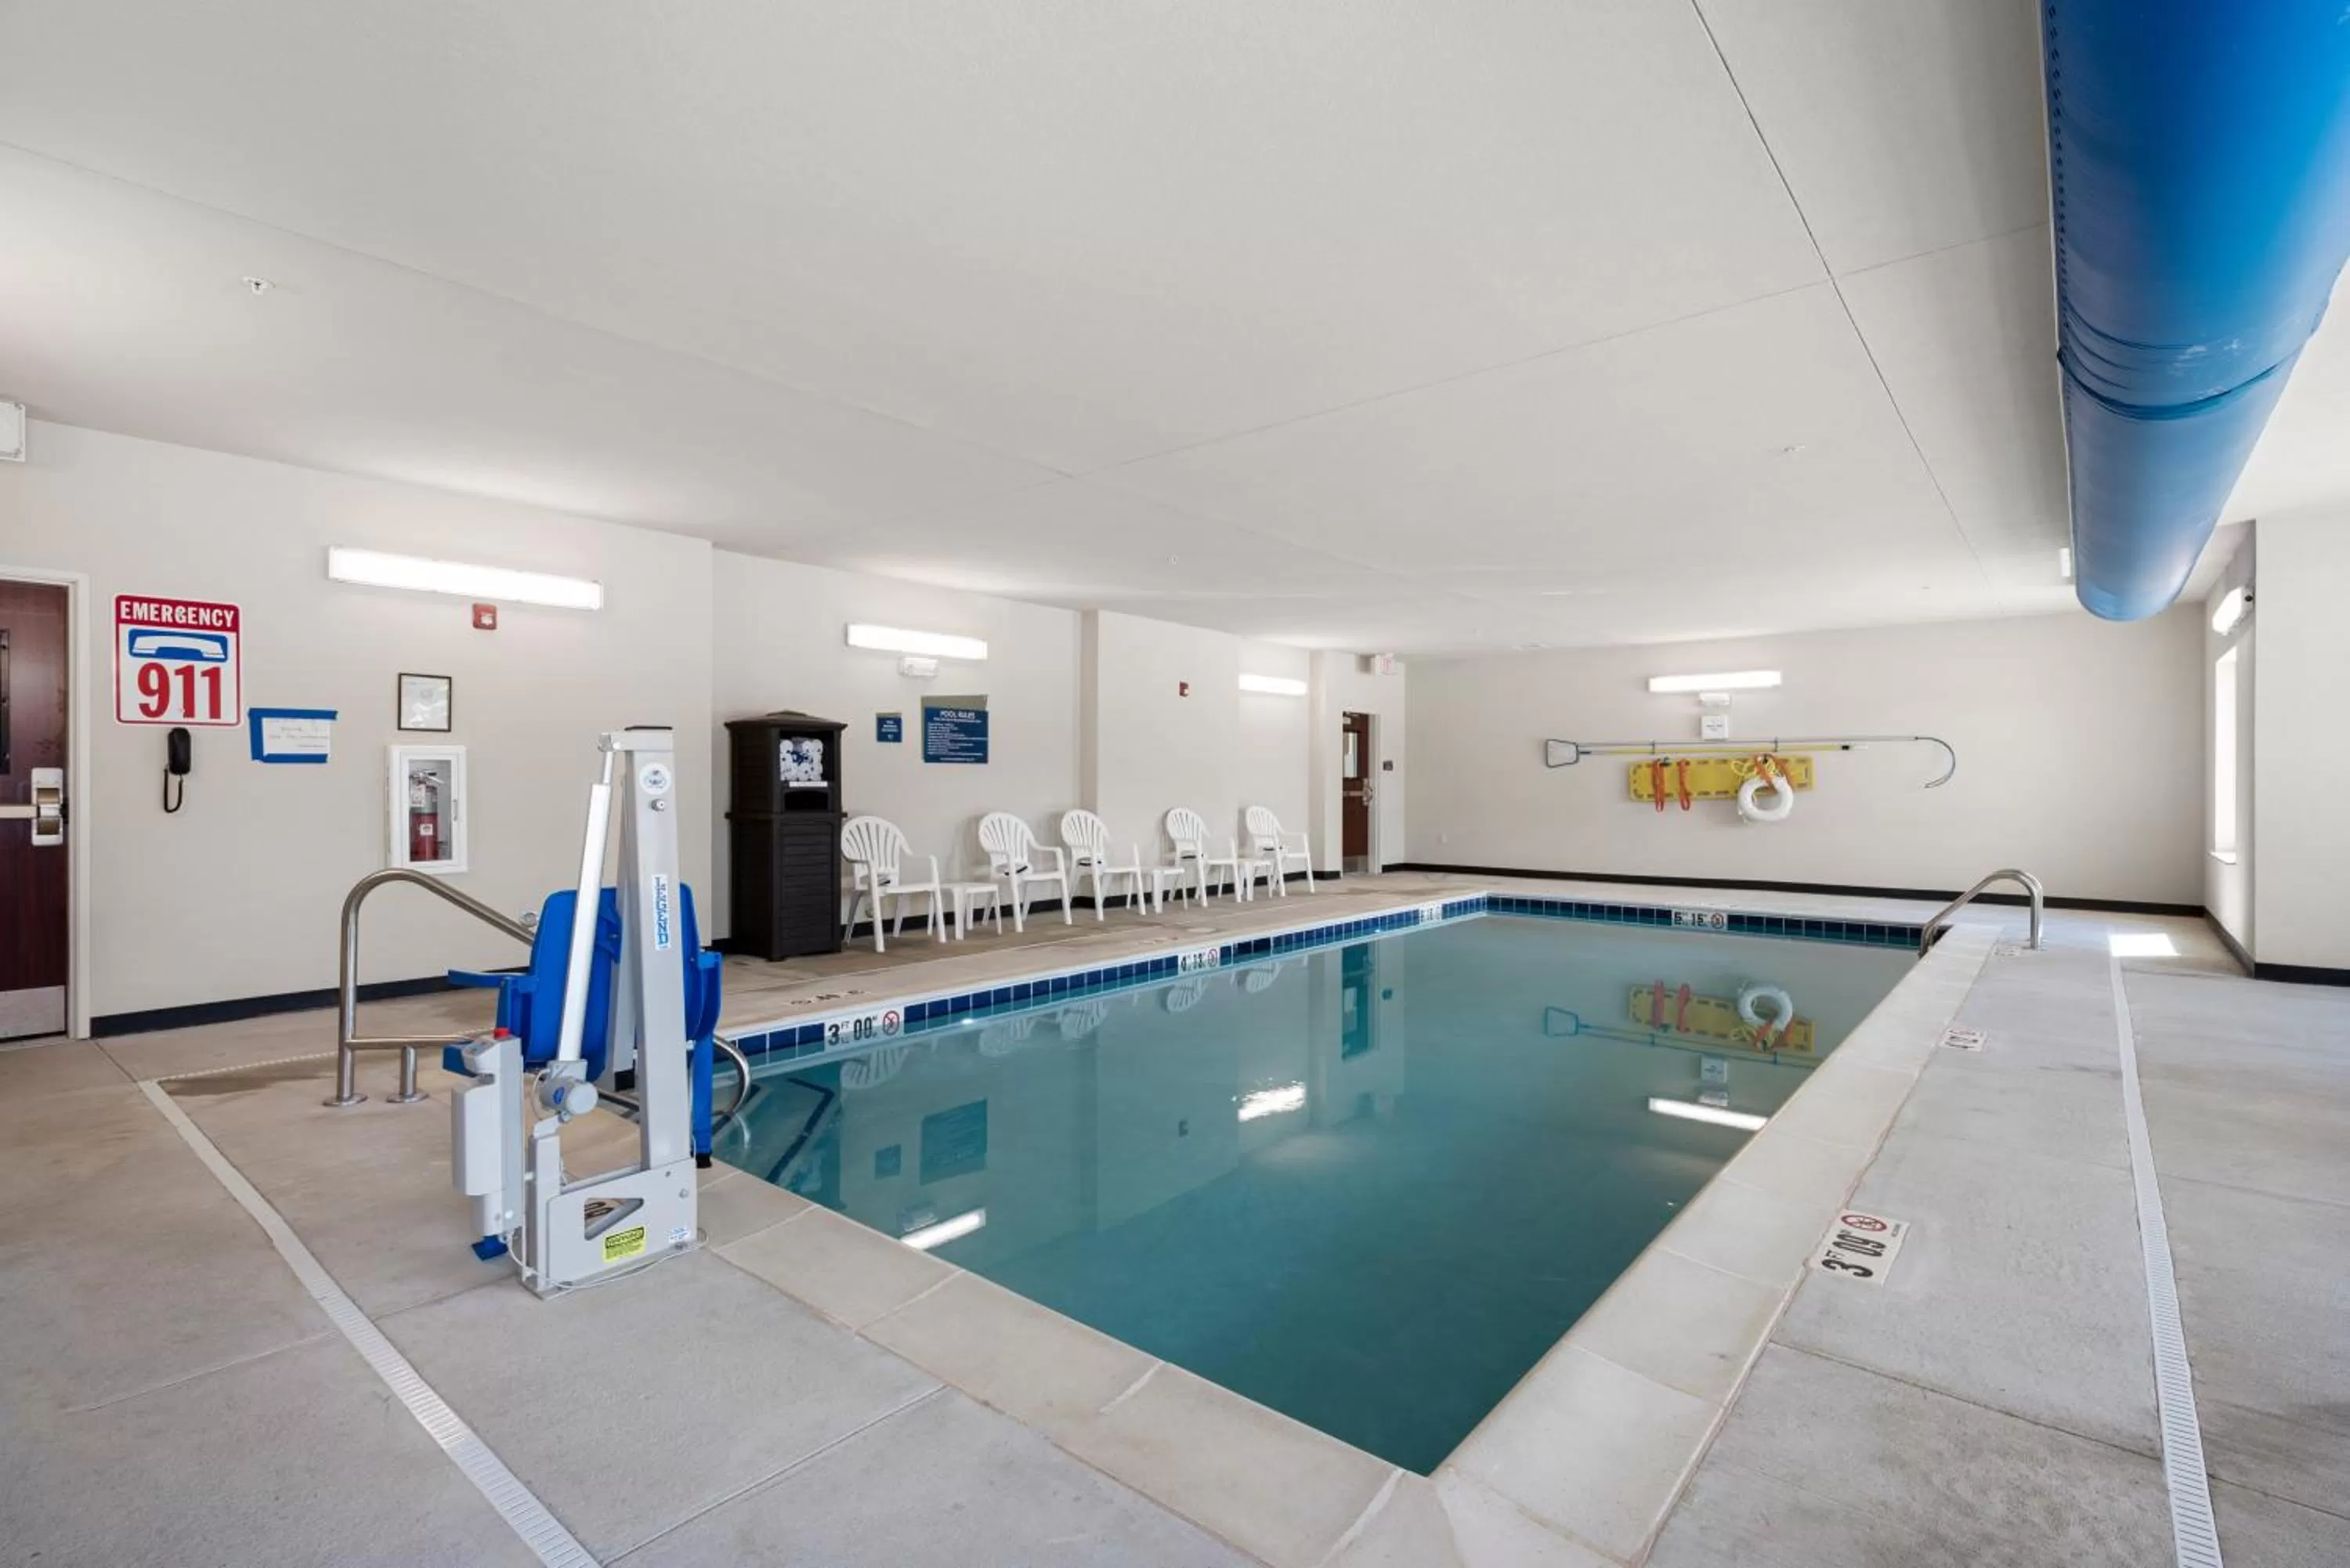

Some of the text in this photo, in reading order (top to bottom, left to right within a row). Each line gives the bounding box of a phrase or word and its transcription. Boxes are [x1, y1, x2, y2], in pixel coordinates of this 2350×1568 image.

[120, 601, 234, 627] EMERGENCY
[137, 662, 221, 720] 911
[828, 1023, 841, 1046] 3
[1821, 1259, 1874, 1278] 3
